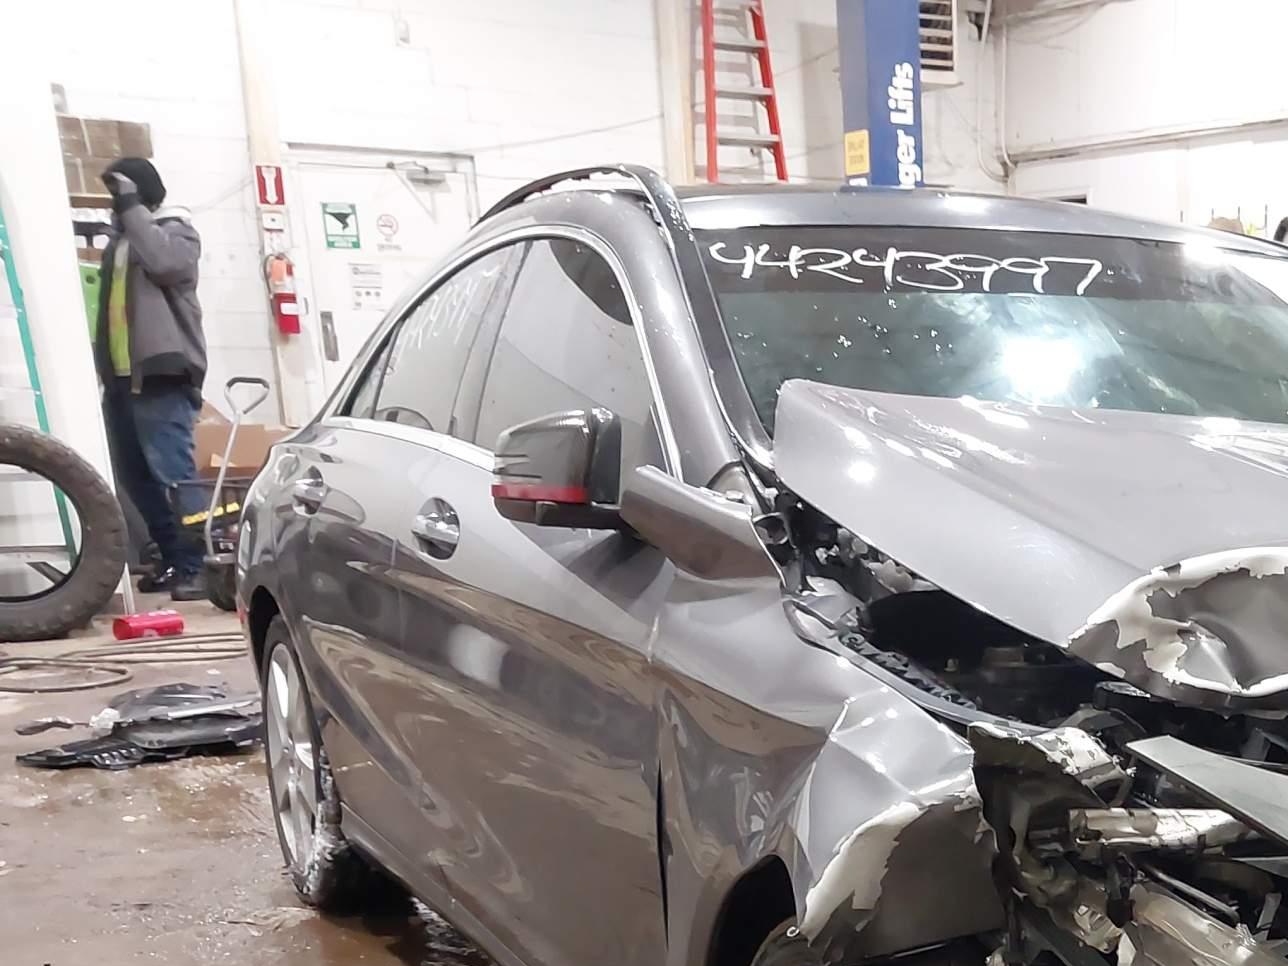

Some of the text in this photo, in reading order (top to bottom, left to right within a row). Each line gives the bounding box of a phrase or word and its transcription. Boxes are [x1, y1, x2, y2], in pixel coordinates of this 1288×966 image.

[887, 62, 922, 189] ger Lifts
[709, 242, 1102, 295] 44243997
